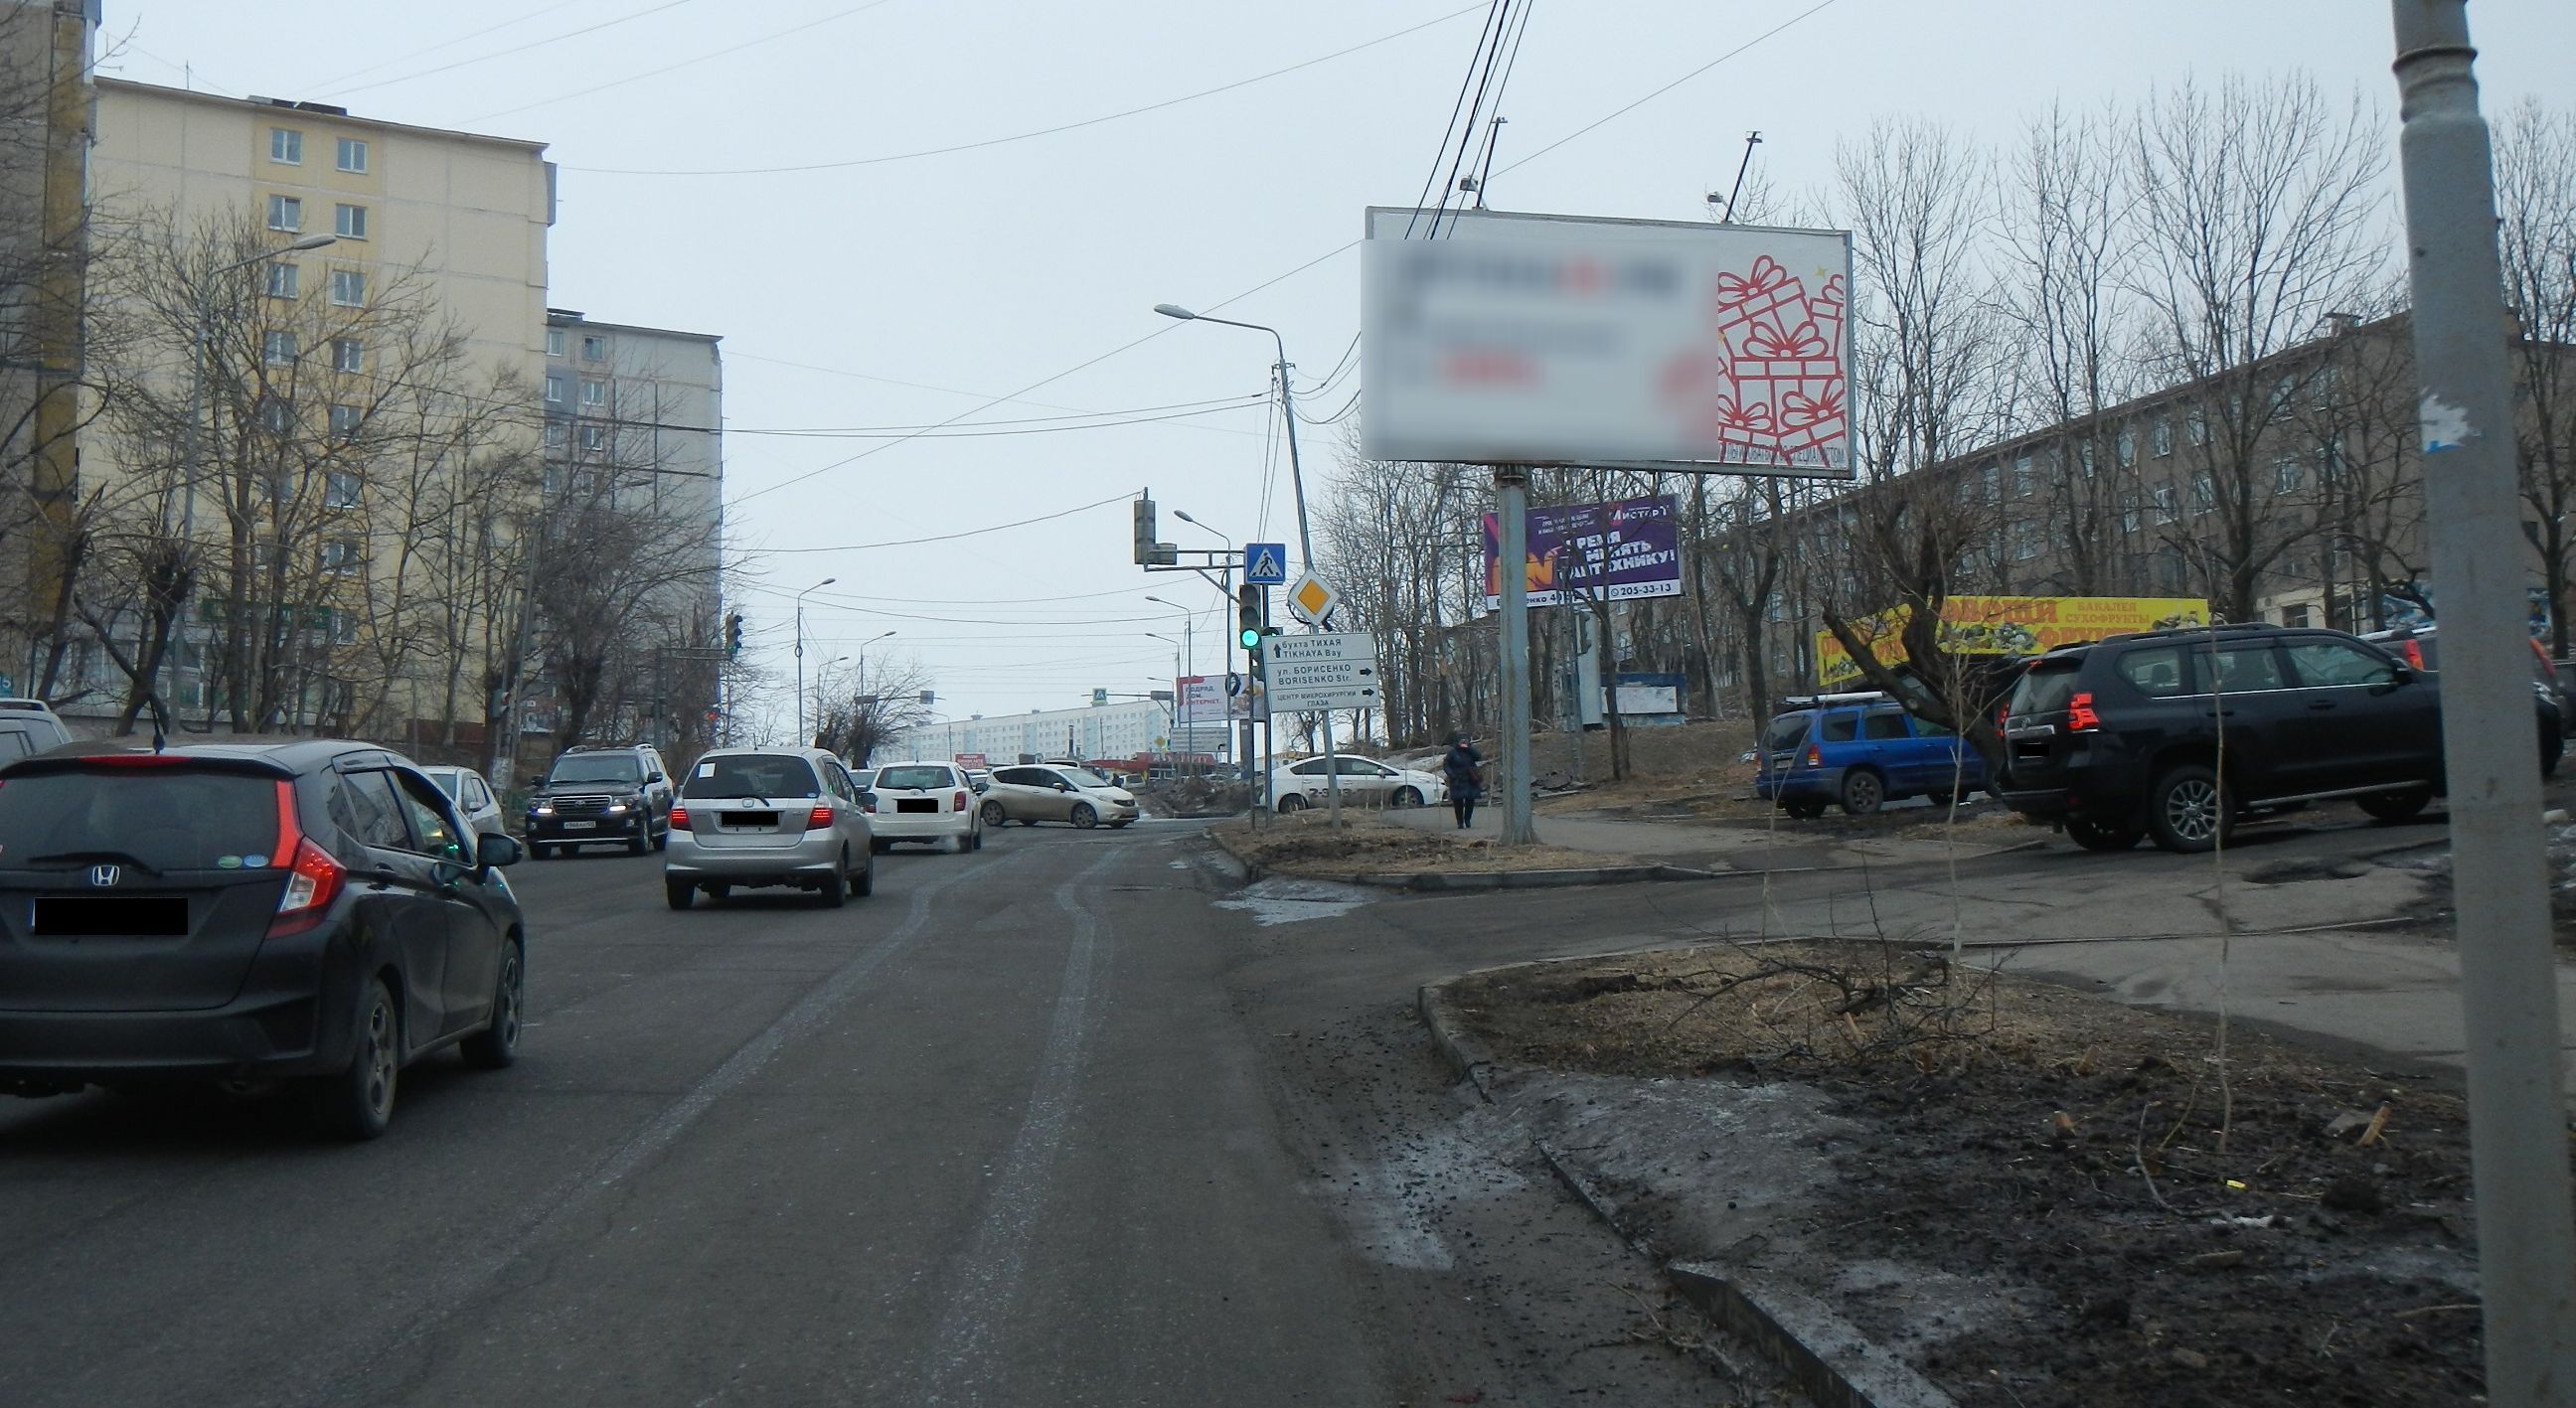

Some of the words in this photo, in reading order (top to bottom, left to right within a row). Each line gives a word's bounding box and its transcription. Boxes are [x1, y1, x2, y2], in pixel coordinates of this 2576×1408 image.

[1621, 583, 1672, 595] 205-33-13
[1940, 599, 2058, 625] ОВОЩИ
[2077, 602, 2136, 612] БАКАЛЕЯ
[2065, 613, 2150, 624] СУХОФРУКТЫ
[1282, 641, 1309, 650] бухта
[1283, 649, 1323, 658] TIKHAYA
[1326, 649, 1342, 658] Bay
[1277, 667, 1291, 676] ул.
[1294, 664, 1352, 675] БОРИСЕНКО
[1278, 675, 1334, 686] BORISENKO
[1336, 673, 1353, 683] Str.
